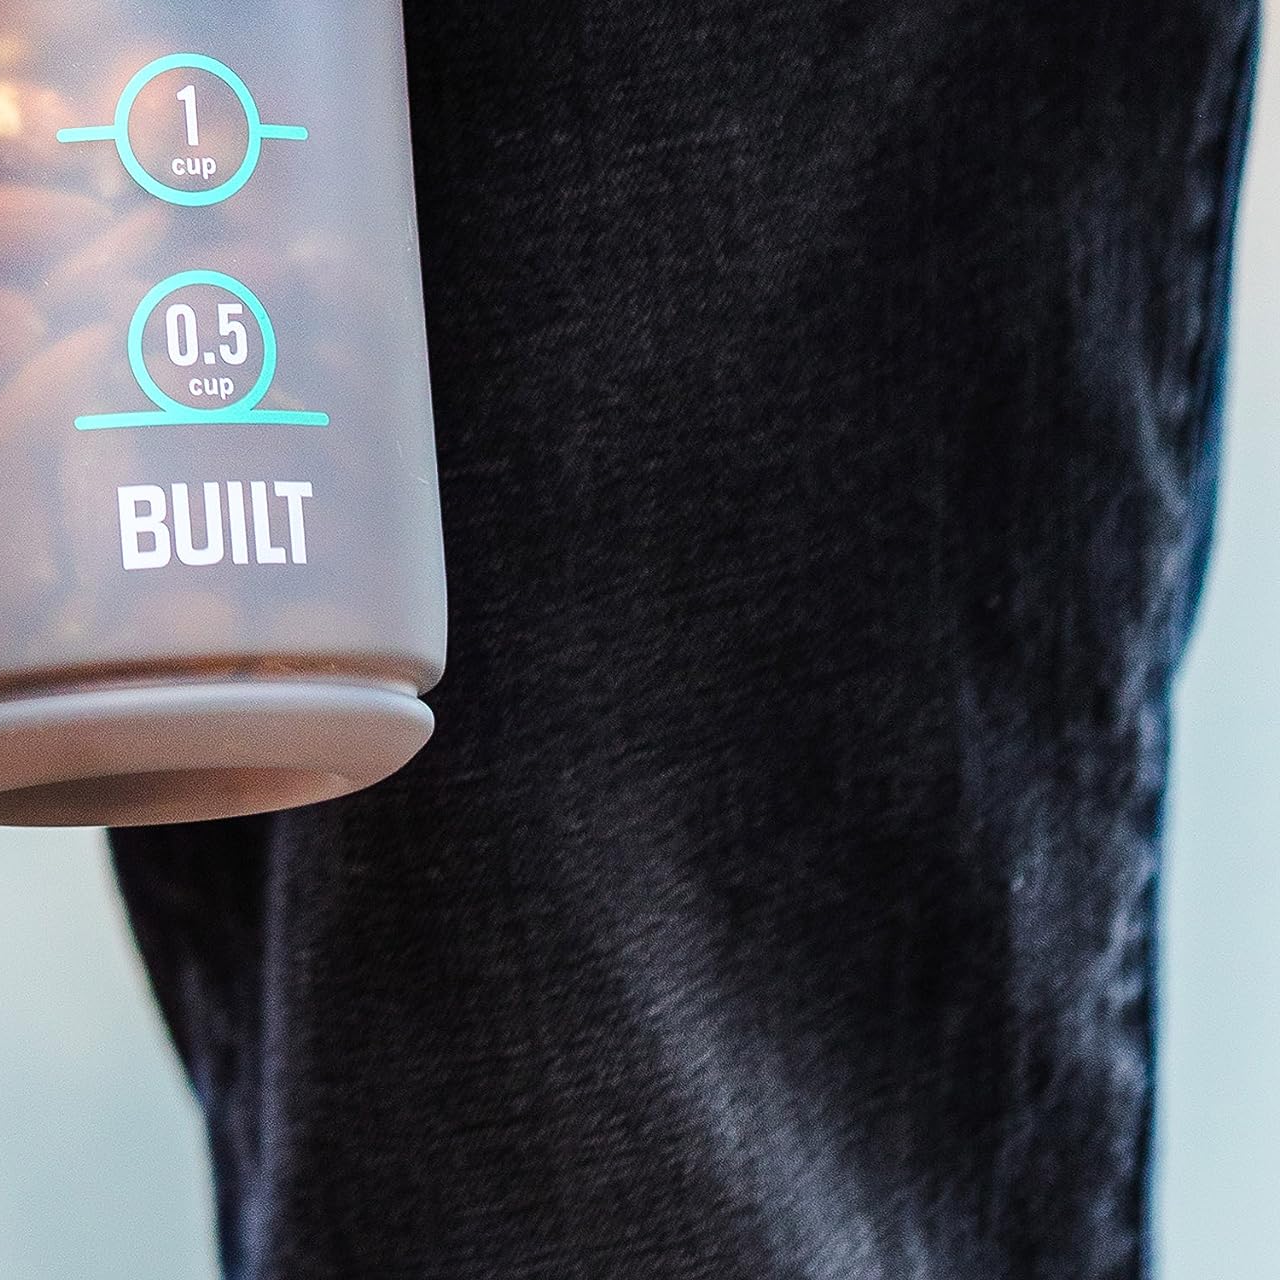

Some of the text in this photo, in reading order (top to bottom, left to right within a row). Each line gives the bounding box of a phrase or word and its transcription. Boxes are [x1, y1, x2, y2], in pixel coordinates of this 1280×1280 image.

[175, 84, 200, 146] 1
[170, 156, 218, 180] cup
[165, 303, 249, 367] 0.5
[188, 376, 235, 401] cup
[117, 480, 314, 571] BUILT
